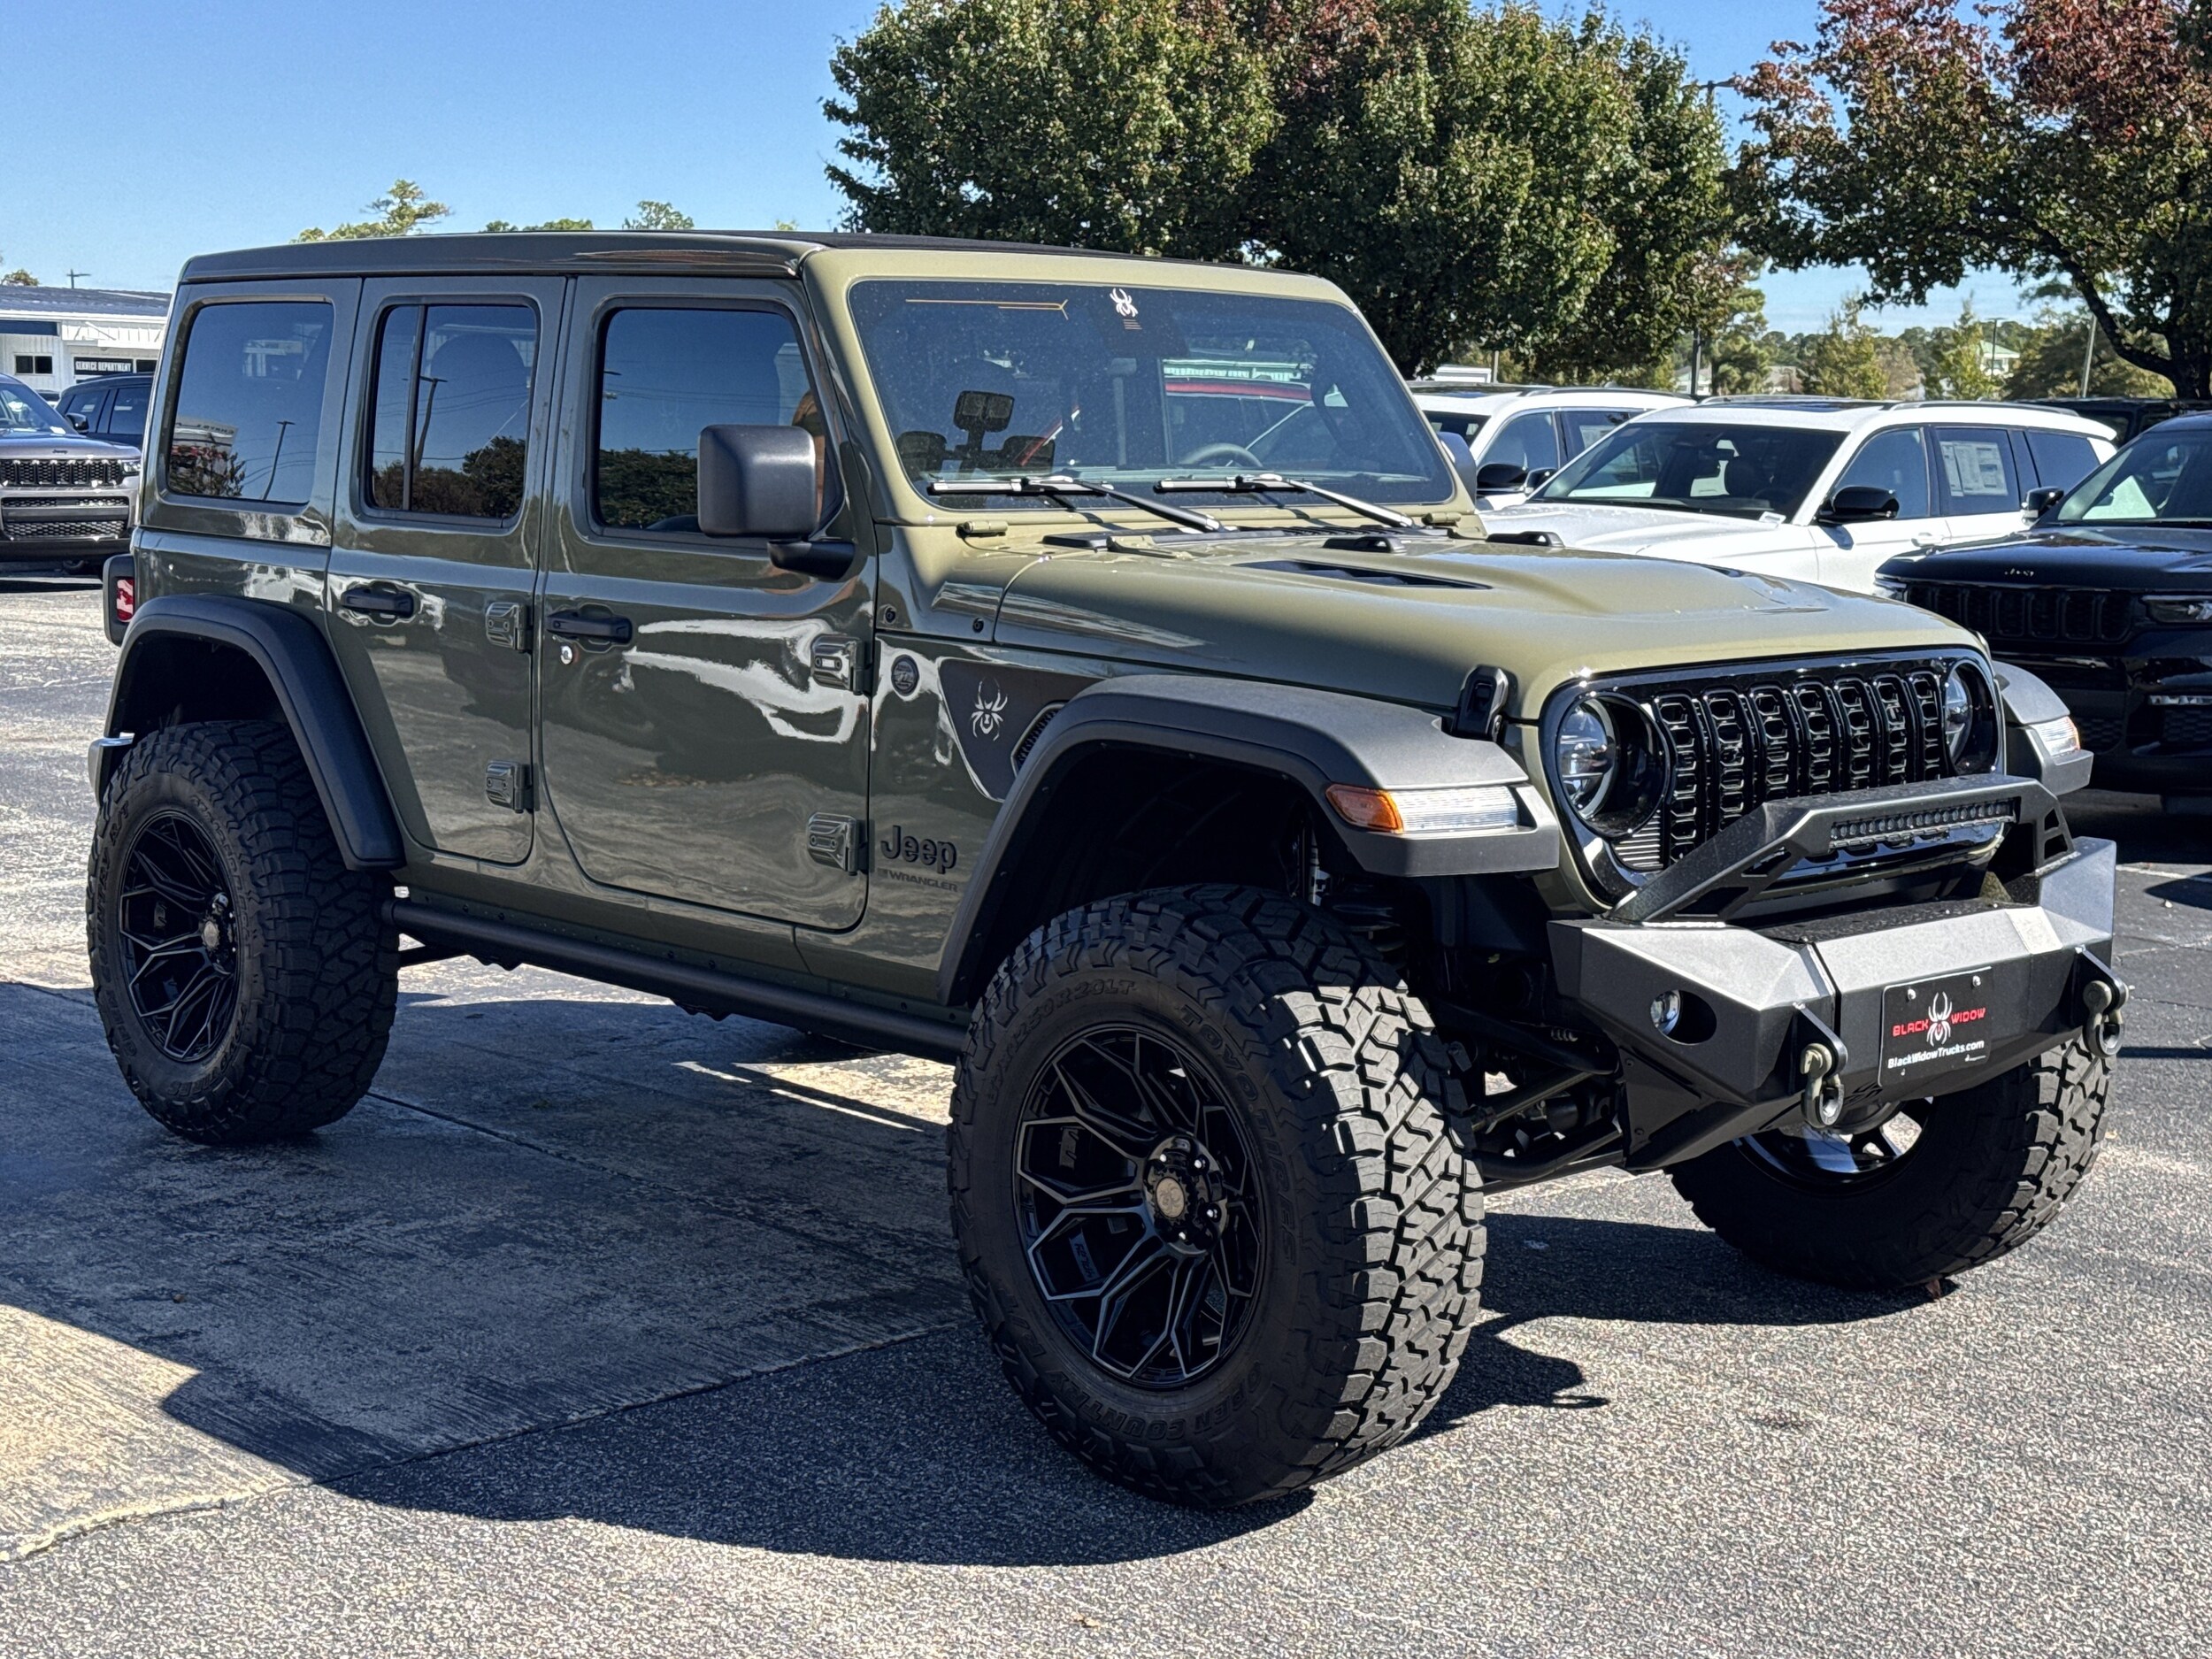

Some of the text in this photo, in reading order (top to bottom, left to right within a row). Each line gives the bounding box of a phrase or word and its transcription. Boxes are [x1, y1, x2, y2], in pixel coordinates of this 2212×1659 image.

[75, 361, 131, 372] SERVICE DEPARTMENT
[880, 825, 957, 874] Jeep
[887, 870, 958, 892] WRANGLER
[1892, 1007, 1986, 1037] BLACK WIDOW
[1887, 1040, 1985, 1069] BlackWidowTrucks.com
[1181, 1003, 1296, 1266] TOYO TIRES
[1049, 1373, 1187, 1440] COUNTRY
[1194, 1363, 1261, 1433] OPEN
